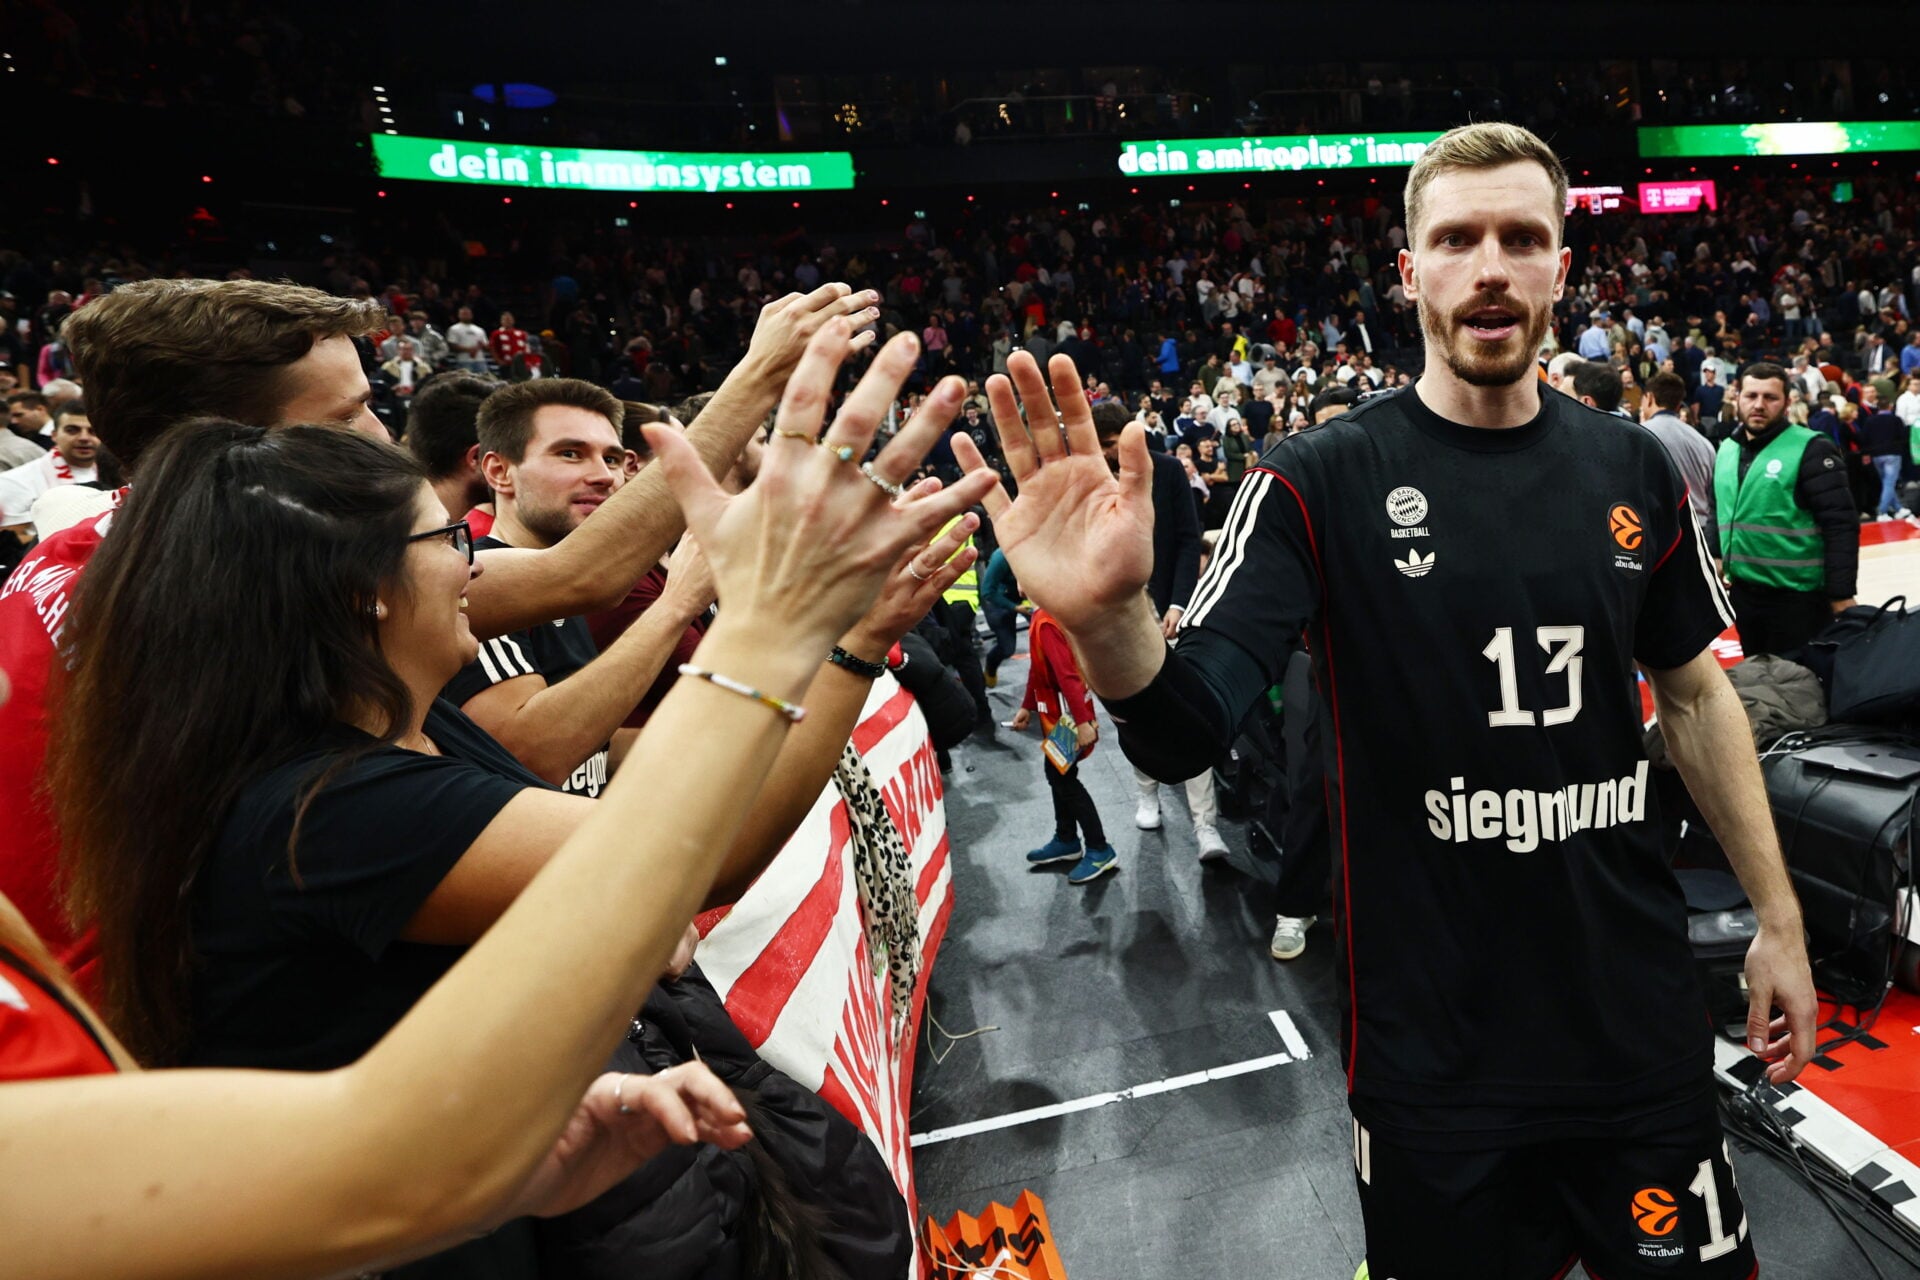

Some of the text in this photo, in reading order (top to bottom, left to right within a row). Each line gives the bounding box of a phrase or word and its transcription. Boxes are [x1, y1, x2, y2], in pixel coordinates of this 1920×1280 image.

[429, 144, 812, 192] dein immunsystem
[1118, 136, 1436, 173] dein aminoplus imm
[1390, 527, 1431, 539] BASKETBALL
[1482, 626, 1584, 727] 13
[1424, 760, 1649, 853] siegmund
[1638, 1244, 1684, 1257] abu dhabi
